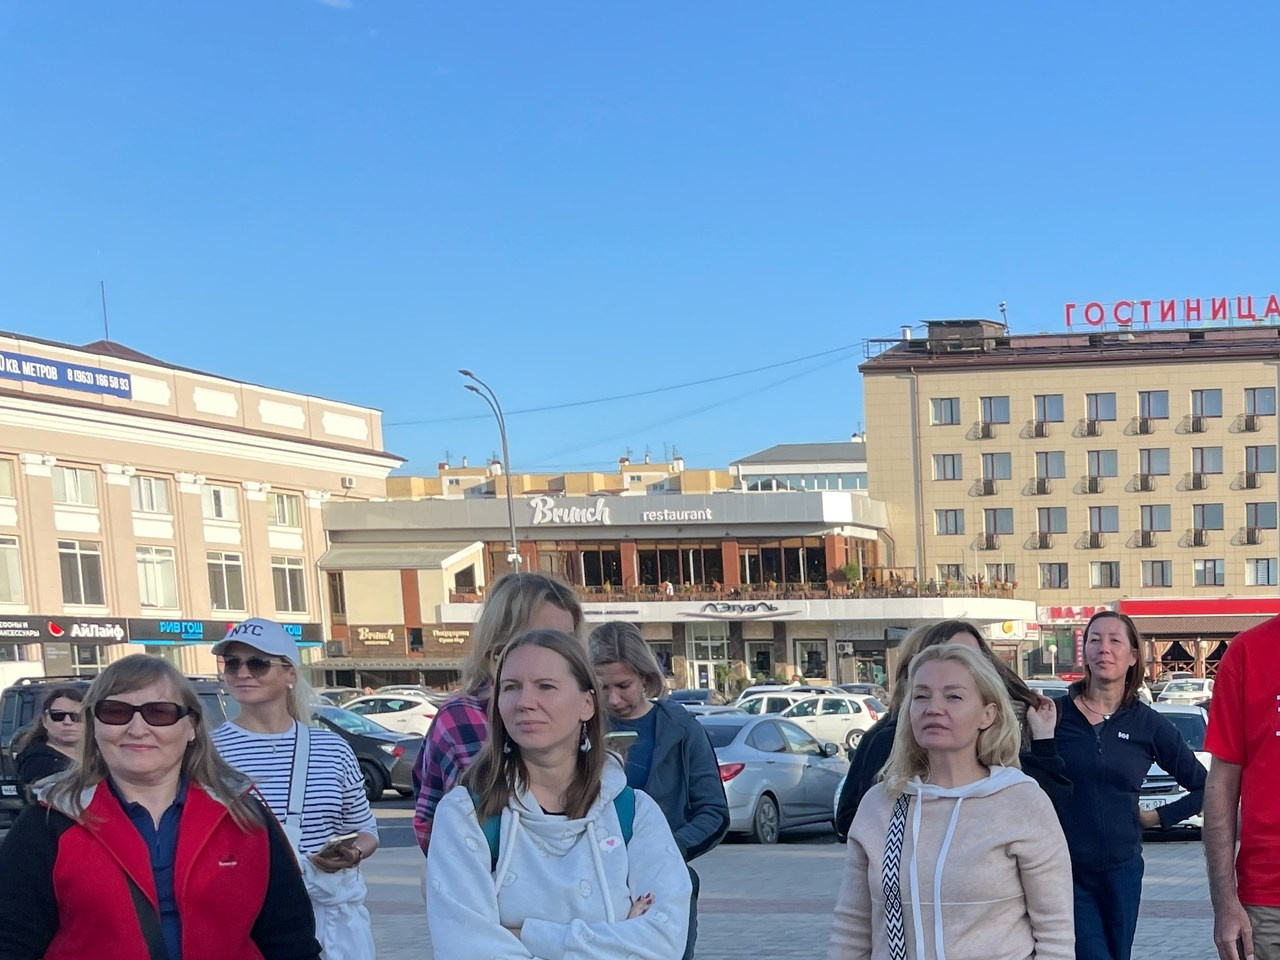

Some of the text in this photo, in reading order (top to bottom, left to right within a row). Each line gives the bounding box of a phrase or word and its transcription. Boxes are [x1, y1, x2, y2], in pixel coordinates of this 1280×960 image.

[22, 360, 58, 380] МЕТРОВ
[67, 368, 73, 381] 8
[120, 378, 130, 391] 93
[530, 496, 712, 525] Brunch restaurant
[70, 623, 124, 640] АйЛайф
[229, 624, 264, 637] NYC
